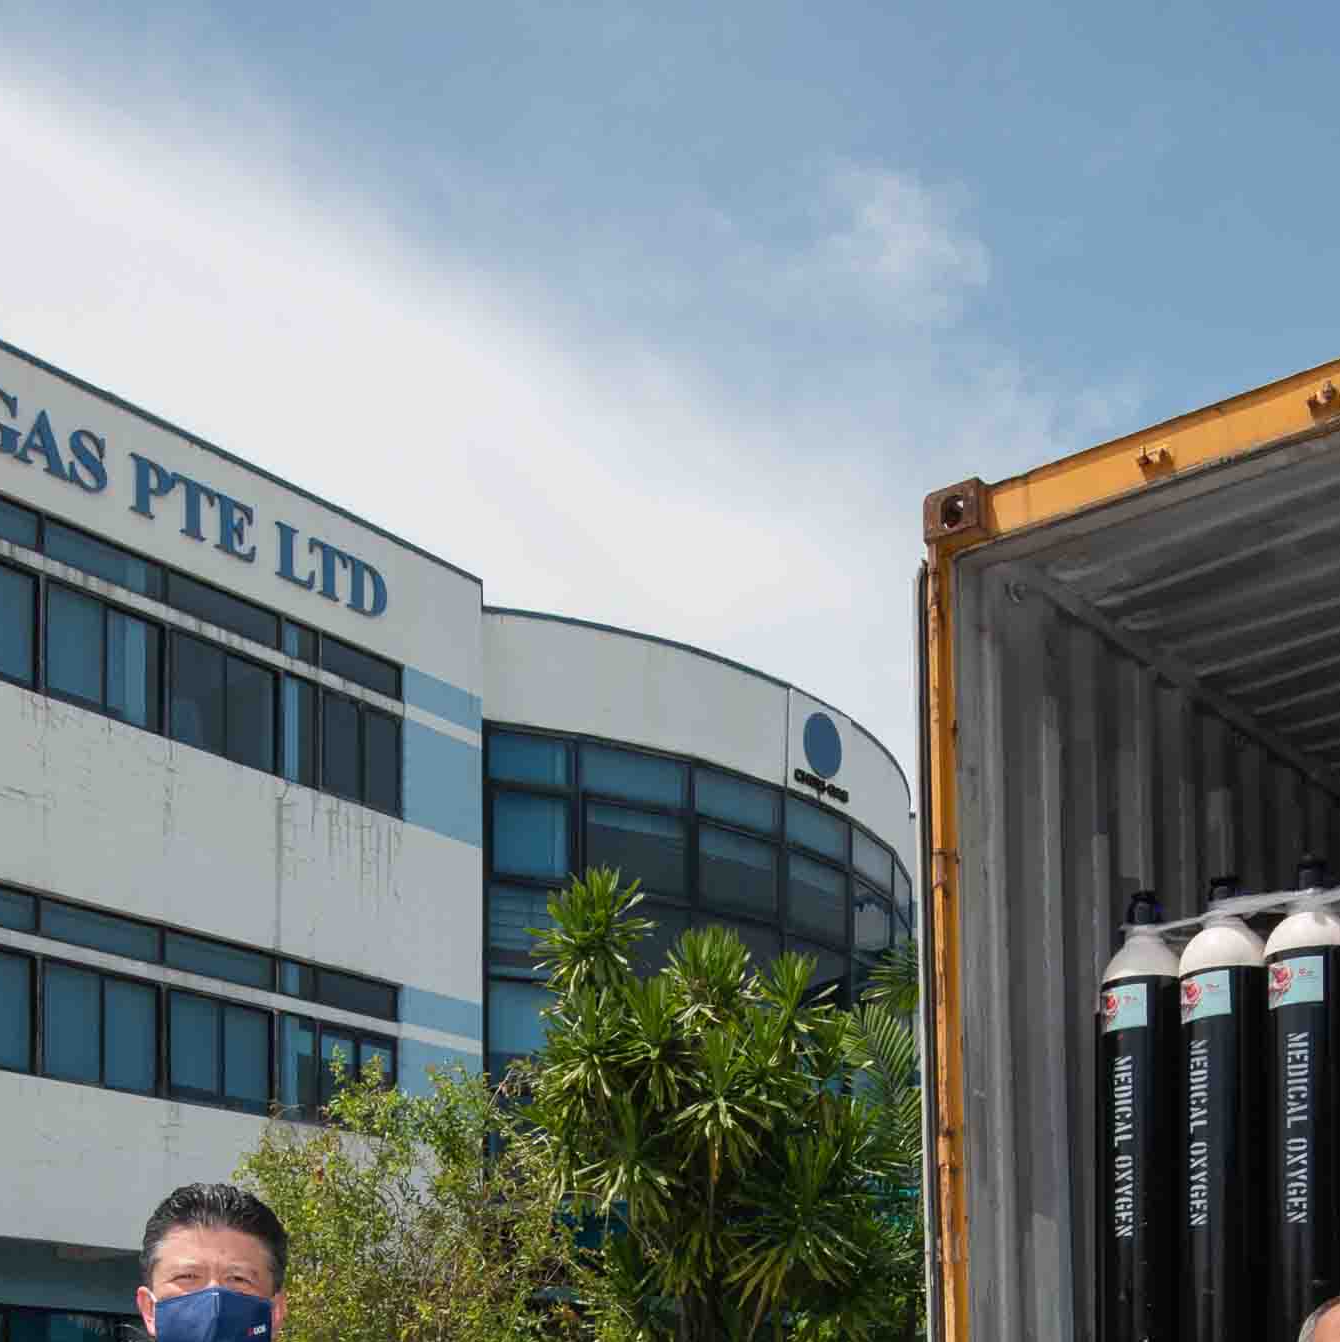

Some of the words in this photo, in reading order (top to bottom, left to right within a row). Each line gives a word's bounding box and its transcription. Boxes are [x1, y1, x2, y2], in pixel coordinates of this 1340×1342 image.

[128, 451, 257, 564] PTE
[275, 519, 388, 618] LTD
[1114, 1055, 1134, 1148] MEDICAL
[1189, 1039, 1210, 1134] MEDICAL
[1285, 1031, 1310, 1130] MEDICAL
[1114, 1154, 1134, 1238] OXYGEN
[1189, 1141, 1209, 1227] OXYGEN
[1285, 1137, 1309, 1225] OXYGEN
